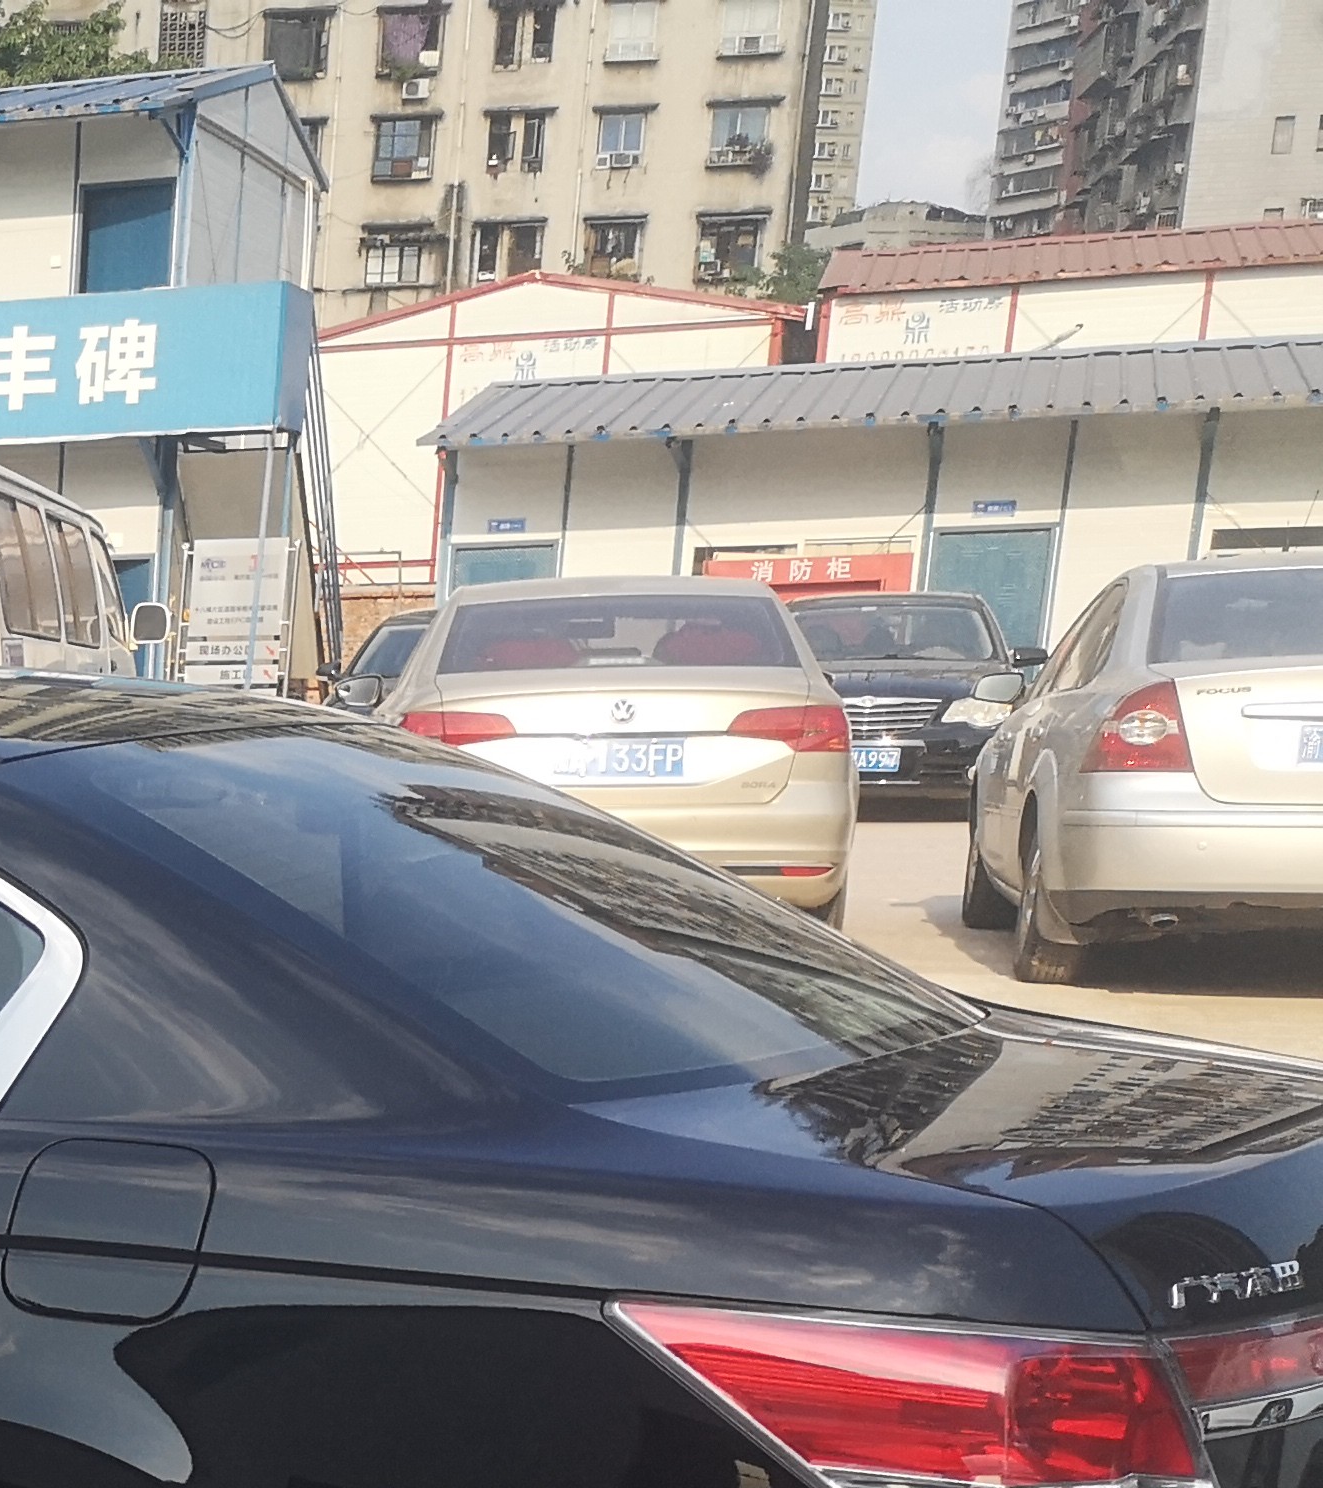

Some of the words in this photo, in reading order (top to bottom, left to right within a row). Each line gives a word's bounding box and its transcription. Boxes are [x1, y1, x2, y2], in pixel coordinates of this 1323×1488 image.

[750, 557, 852, 582] 消防柜
[1196, 686, 1252, 695] FOCUS
